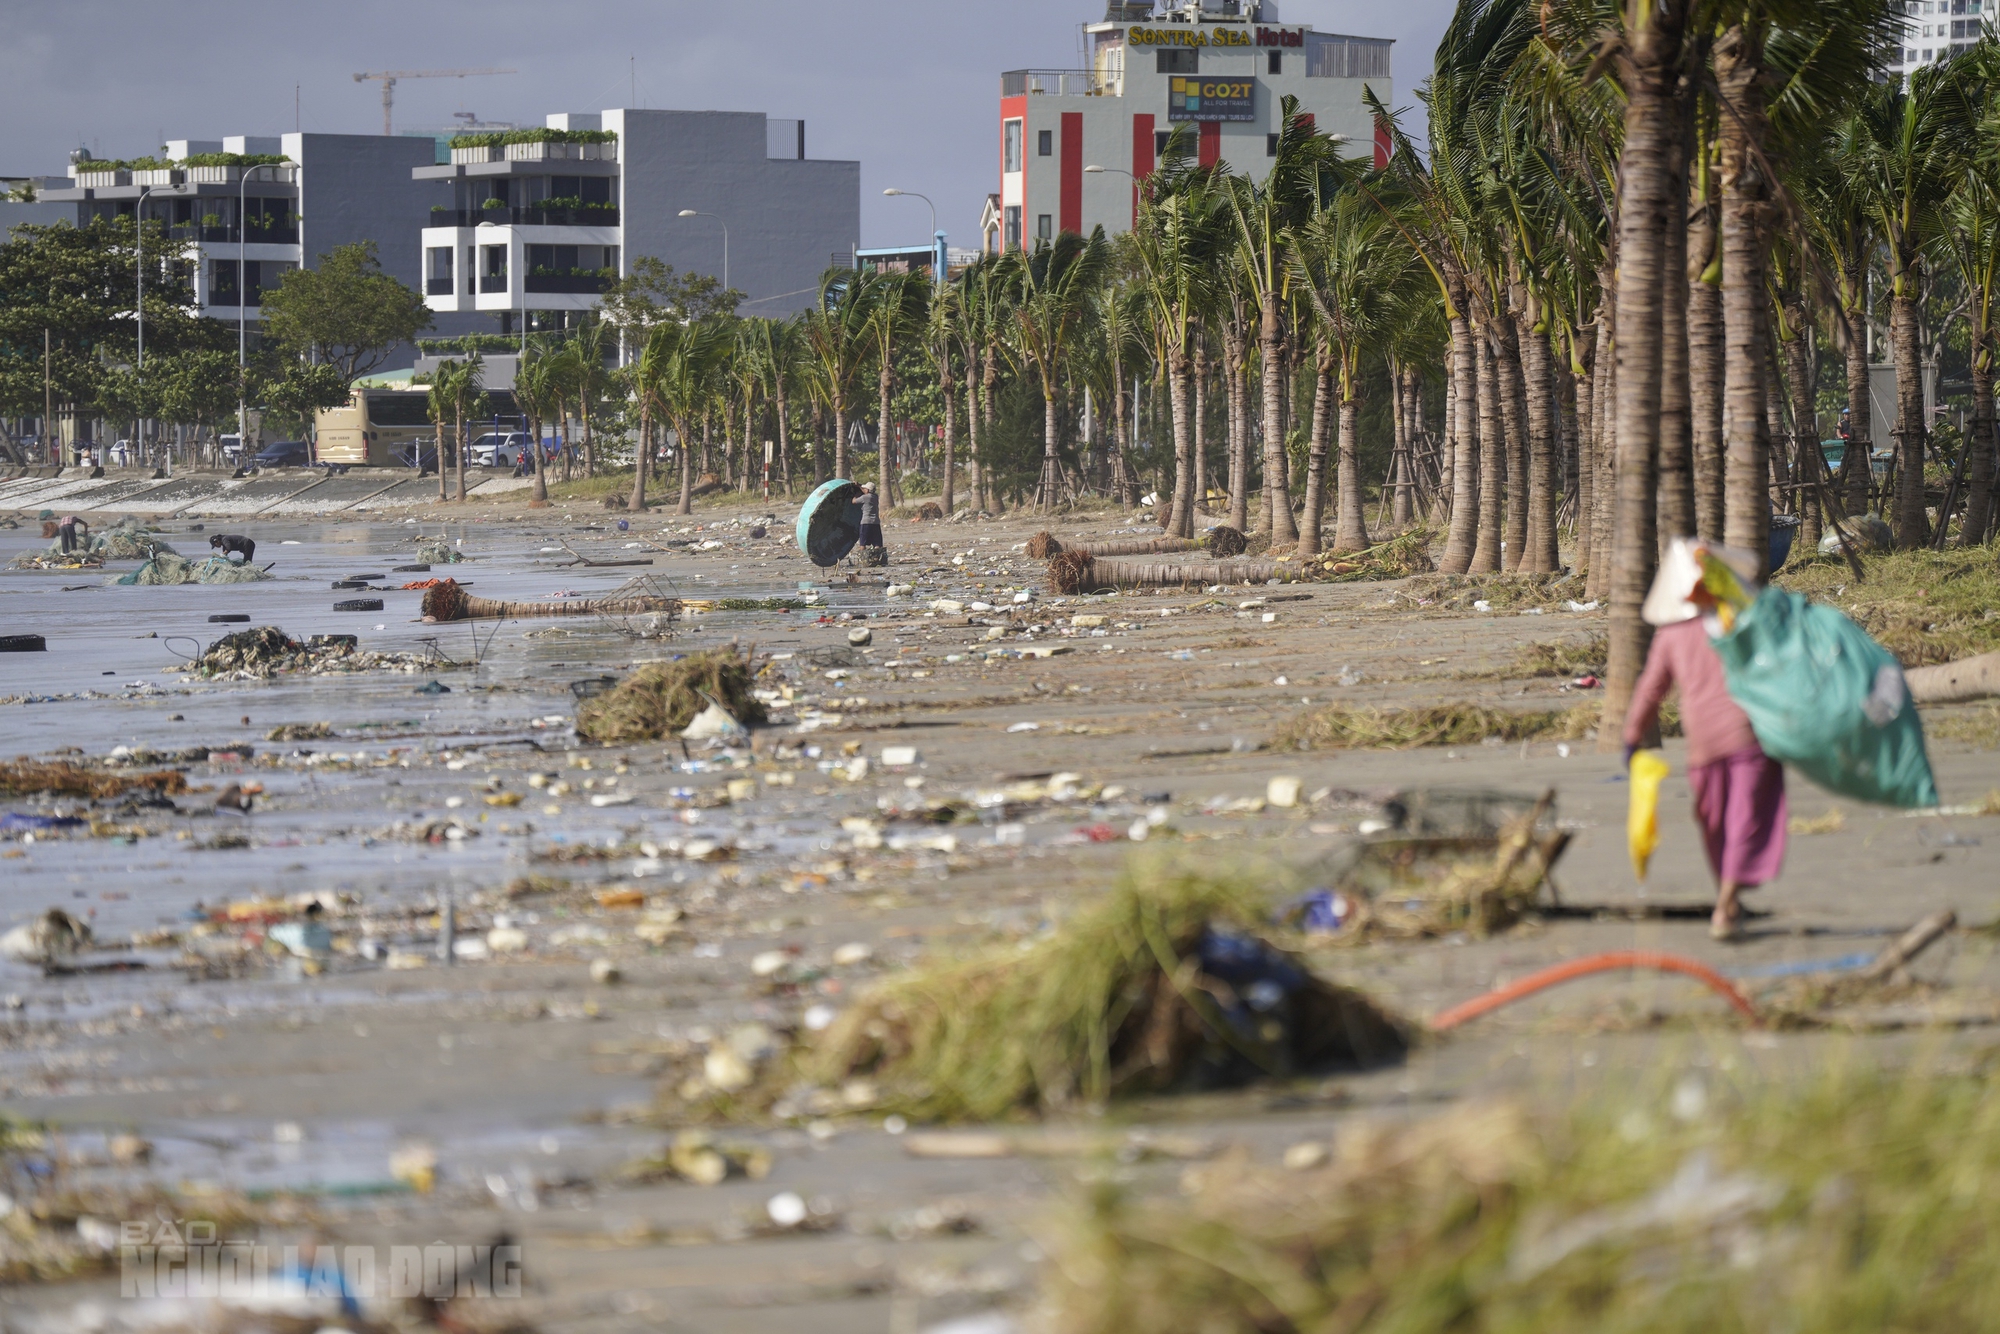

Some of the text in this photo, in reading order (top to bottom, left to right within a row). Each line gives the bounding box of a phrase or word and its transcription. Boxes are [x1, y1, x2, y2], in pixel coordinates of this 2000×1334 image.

[1128, 26, 1303, 48] SONTRA SEA Hotel
[1202, 83, 1252, 98] GO2T
